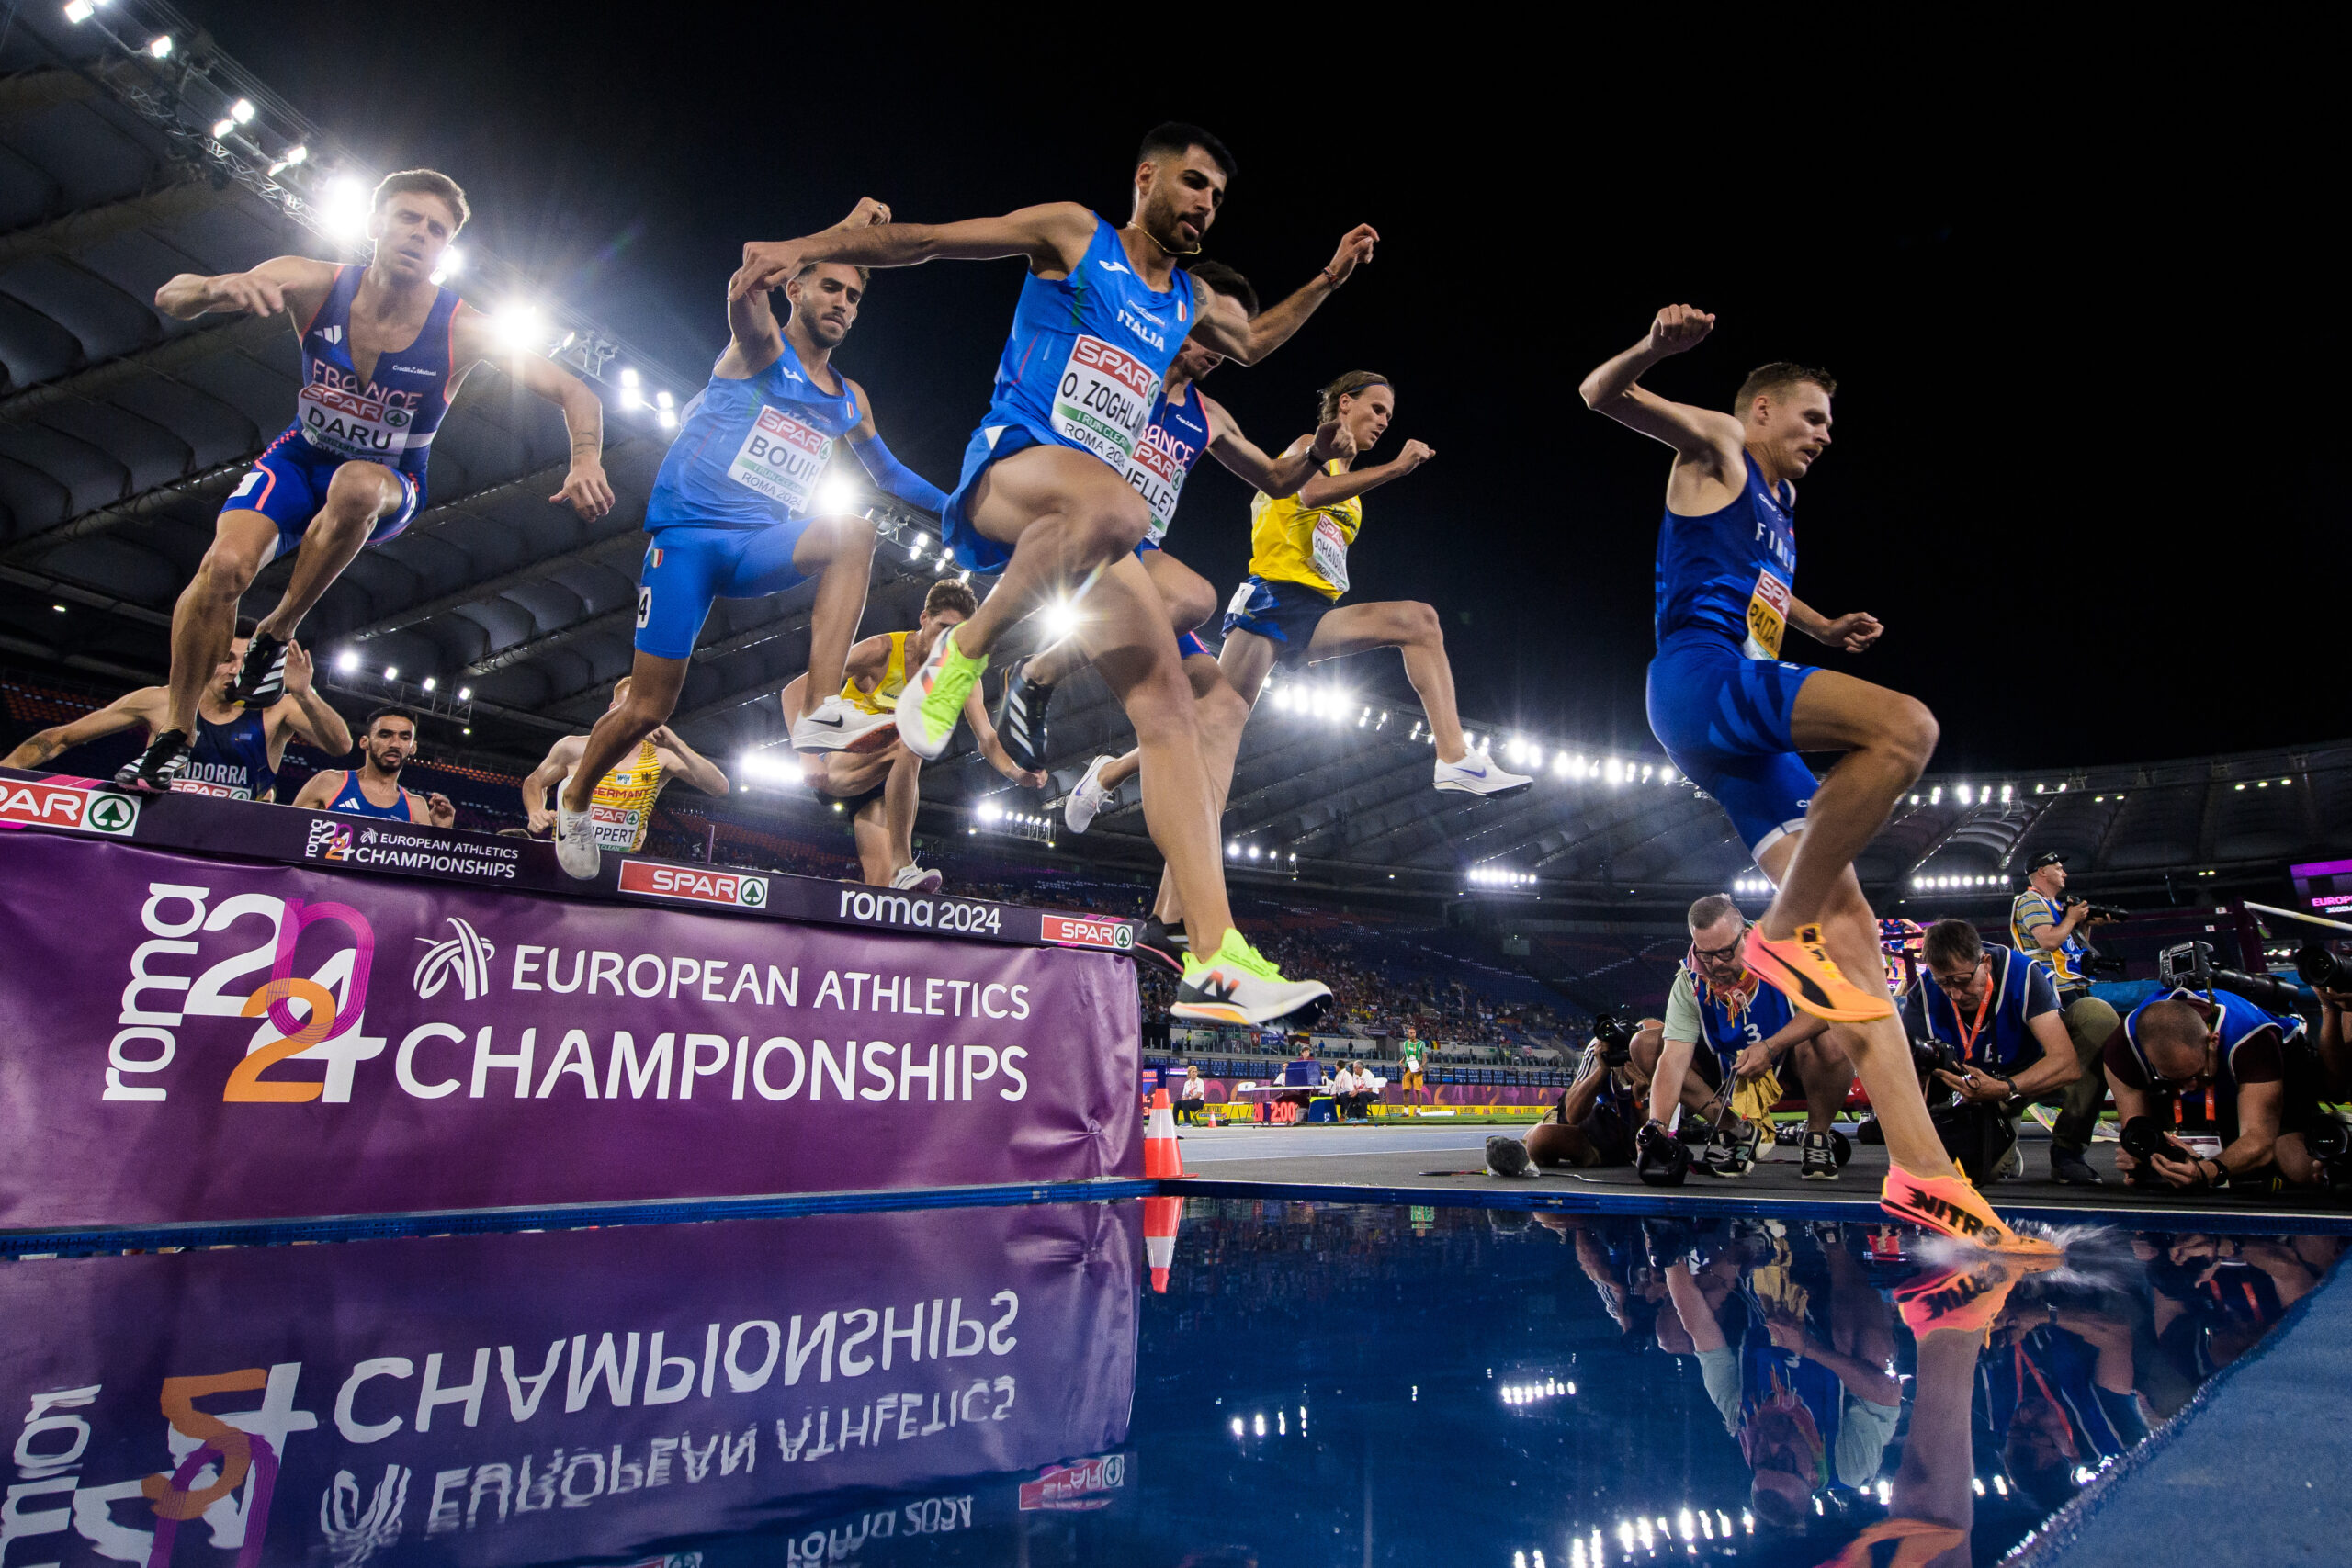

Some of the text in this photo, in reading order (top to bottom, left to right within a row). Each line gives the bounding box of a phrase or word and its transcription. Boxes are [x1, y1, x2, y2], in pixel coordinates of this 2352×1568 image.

[1117, 309, 1164, 352] ITALIA
[1077, 341, 1149, 394] SPAR
[312, 358, 423, 412] FRANCE
[304, 387, 379, 420] SPAR
[1062, 372, 1078, 401] O.
[1082, 380, 1147, 440] ZOGHL
[308, 406, 392, 450] DARU
[760, 412, 820, 453] SPAR
[1065, 423, 1105, 453] ROMA
[1083, 415, 1102, 434] RUN
[1135, 445, 1174, 479] PAR
[1142, 423, 1194, 471] ANCE
[741, 472, 802, 507] ROMA 2024
[1125, 468, 1175, 516] IELLET
[183, 761, 247, 784] NDORRA
[0, 788, 82, 821] AR
[591, 808, 626, 823] PAR
[305, 819, 323, 858] roma
[380, 833, 519, 860] EUROPEAN ATHLETICS
[593, 826, 636, 844] PPERT
[356, 847, 517, 879] CHAMPIONSHIPS
[652, 868, 738, 900] SPAR
[840, 889, 1001, 936] roma 2024
[2311, 895, 2352, 908] EUROP
[1061, 921, 1114, 946] SPAR
[102, 882, 210, 1102] roma
[511, 946, 1030, 1021] EUROPEAN ATHLETICS
[1744, 1023, 1762, 1044] 3
[395, 1022, 1028, 1102] CHAMPIONSHIPS
